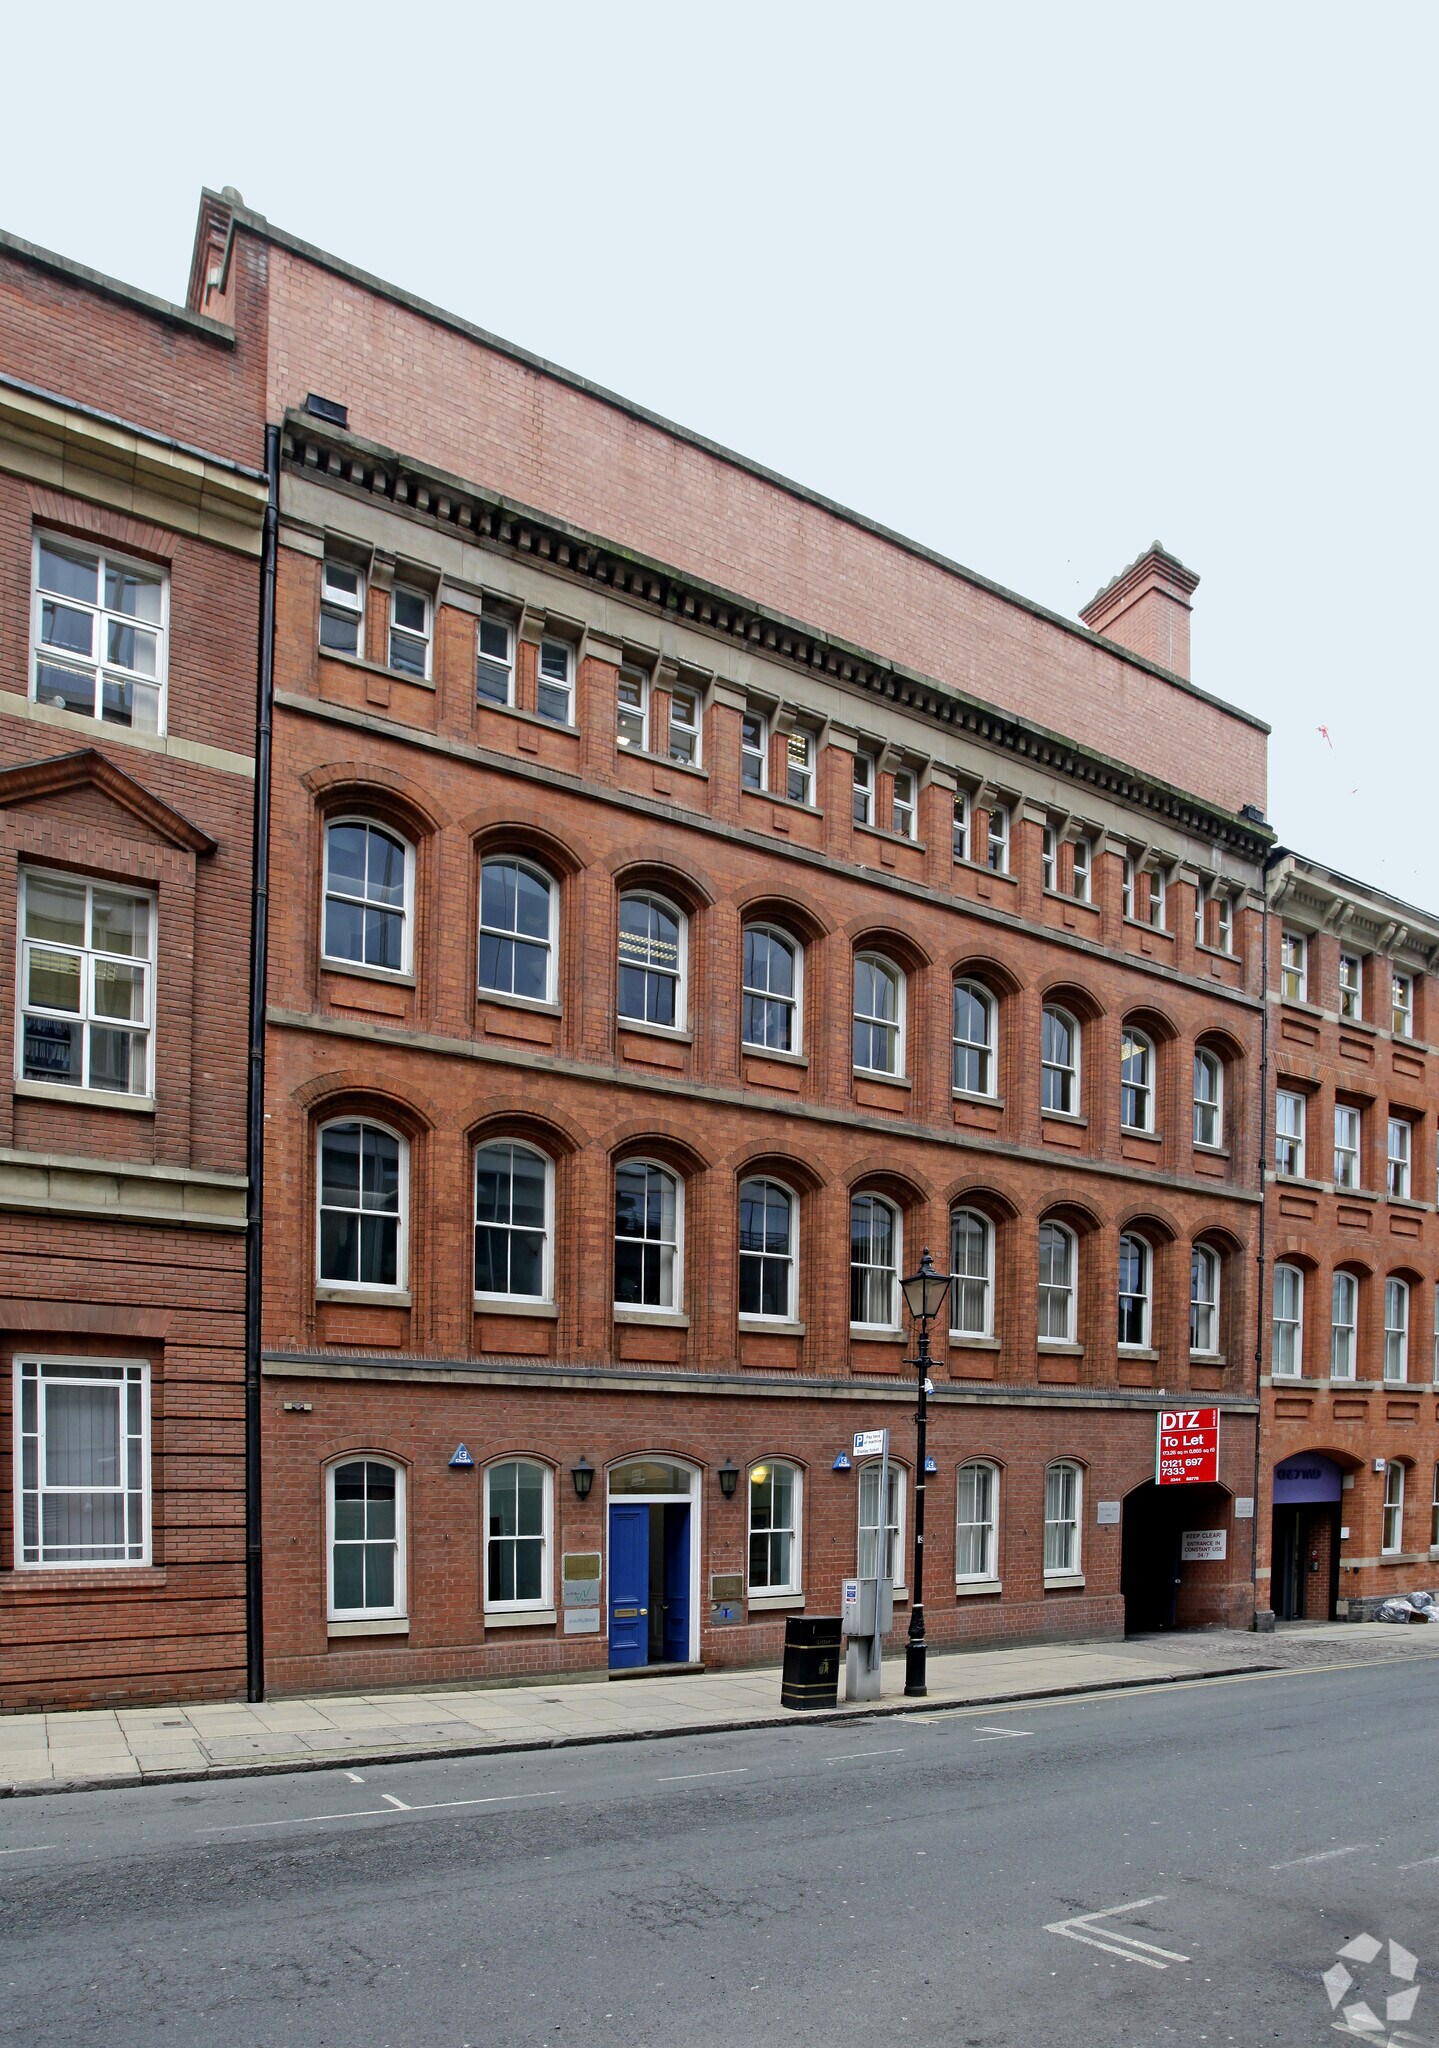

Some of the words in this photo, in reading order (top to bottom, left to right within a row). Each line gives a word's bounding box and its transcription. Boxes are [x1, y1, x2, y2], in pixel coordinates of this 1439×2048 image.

[1162, 1411, 1200, 1430] DTZ
[856, 1435, 863, 1447] P
[1162, 1436, 1179, 1447] To
[1183, 1434, 1204, 1446] Let
[1162, 1459, 1182, 1468] 0121
[1185, 1458, 1203, 1466] 697
